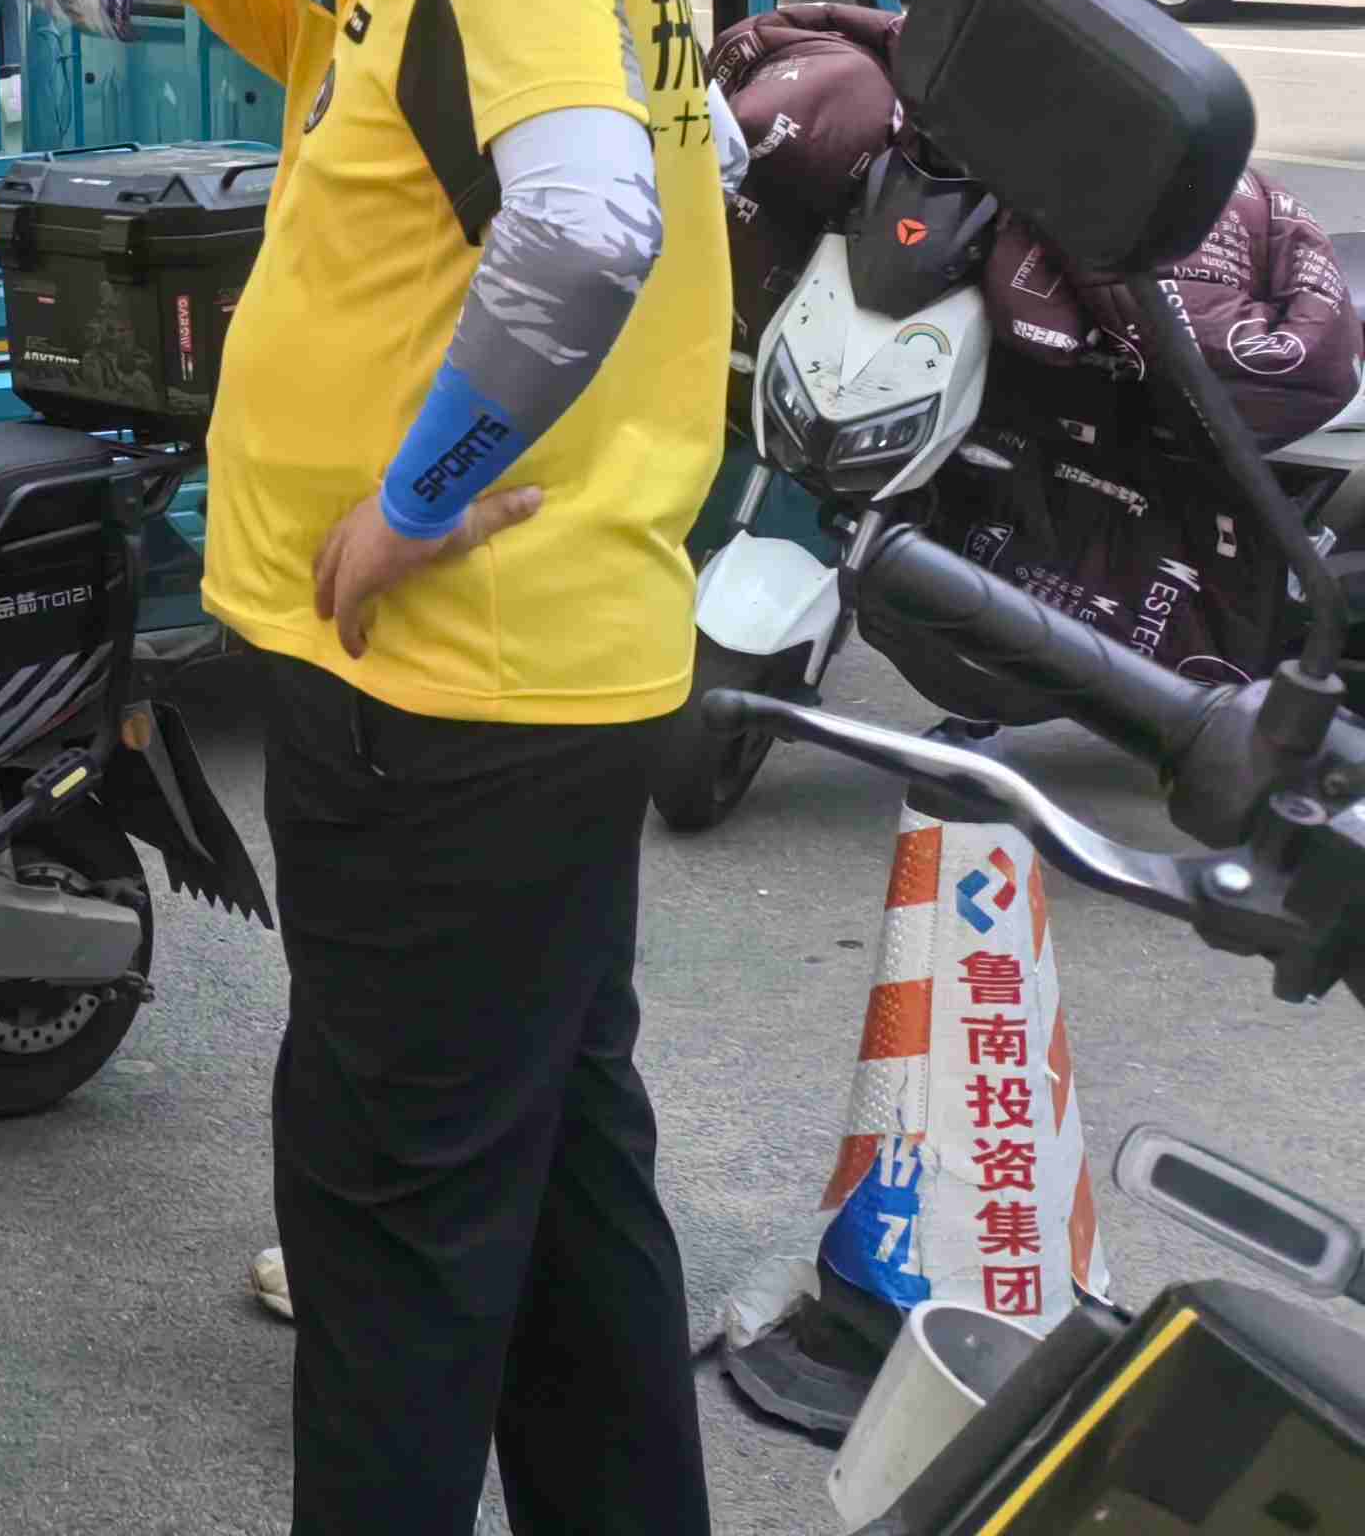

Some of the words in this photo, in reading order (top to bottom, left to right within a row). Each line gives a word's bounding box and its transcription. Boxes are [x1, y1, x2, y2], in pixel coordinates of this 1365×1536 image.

[412, 413, 511, 503] SPORTS
[957, 950, 1043, 1316] 鲁南投资集团
